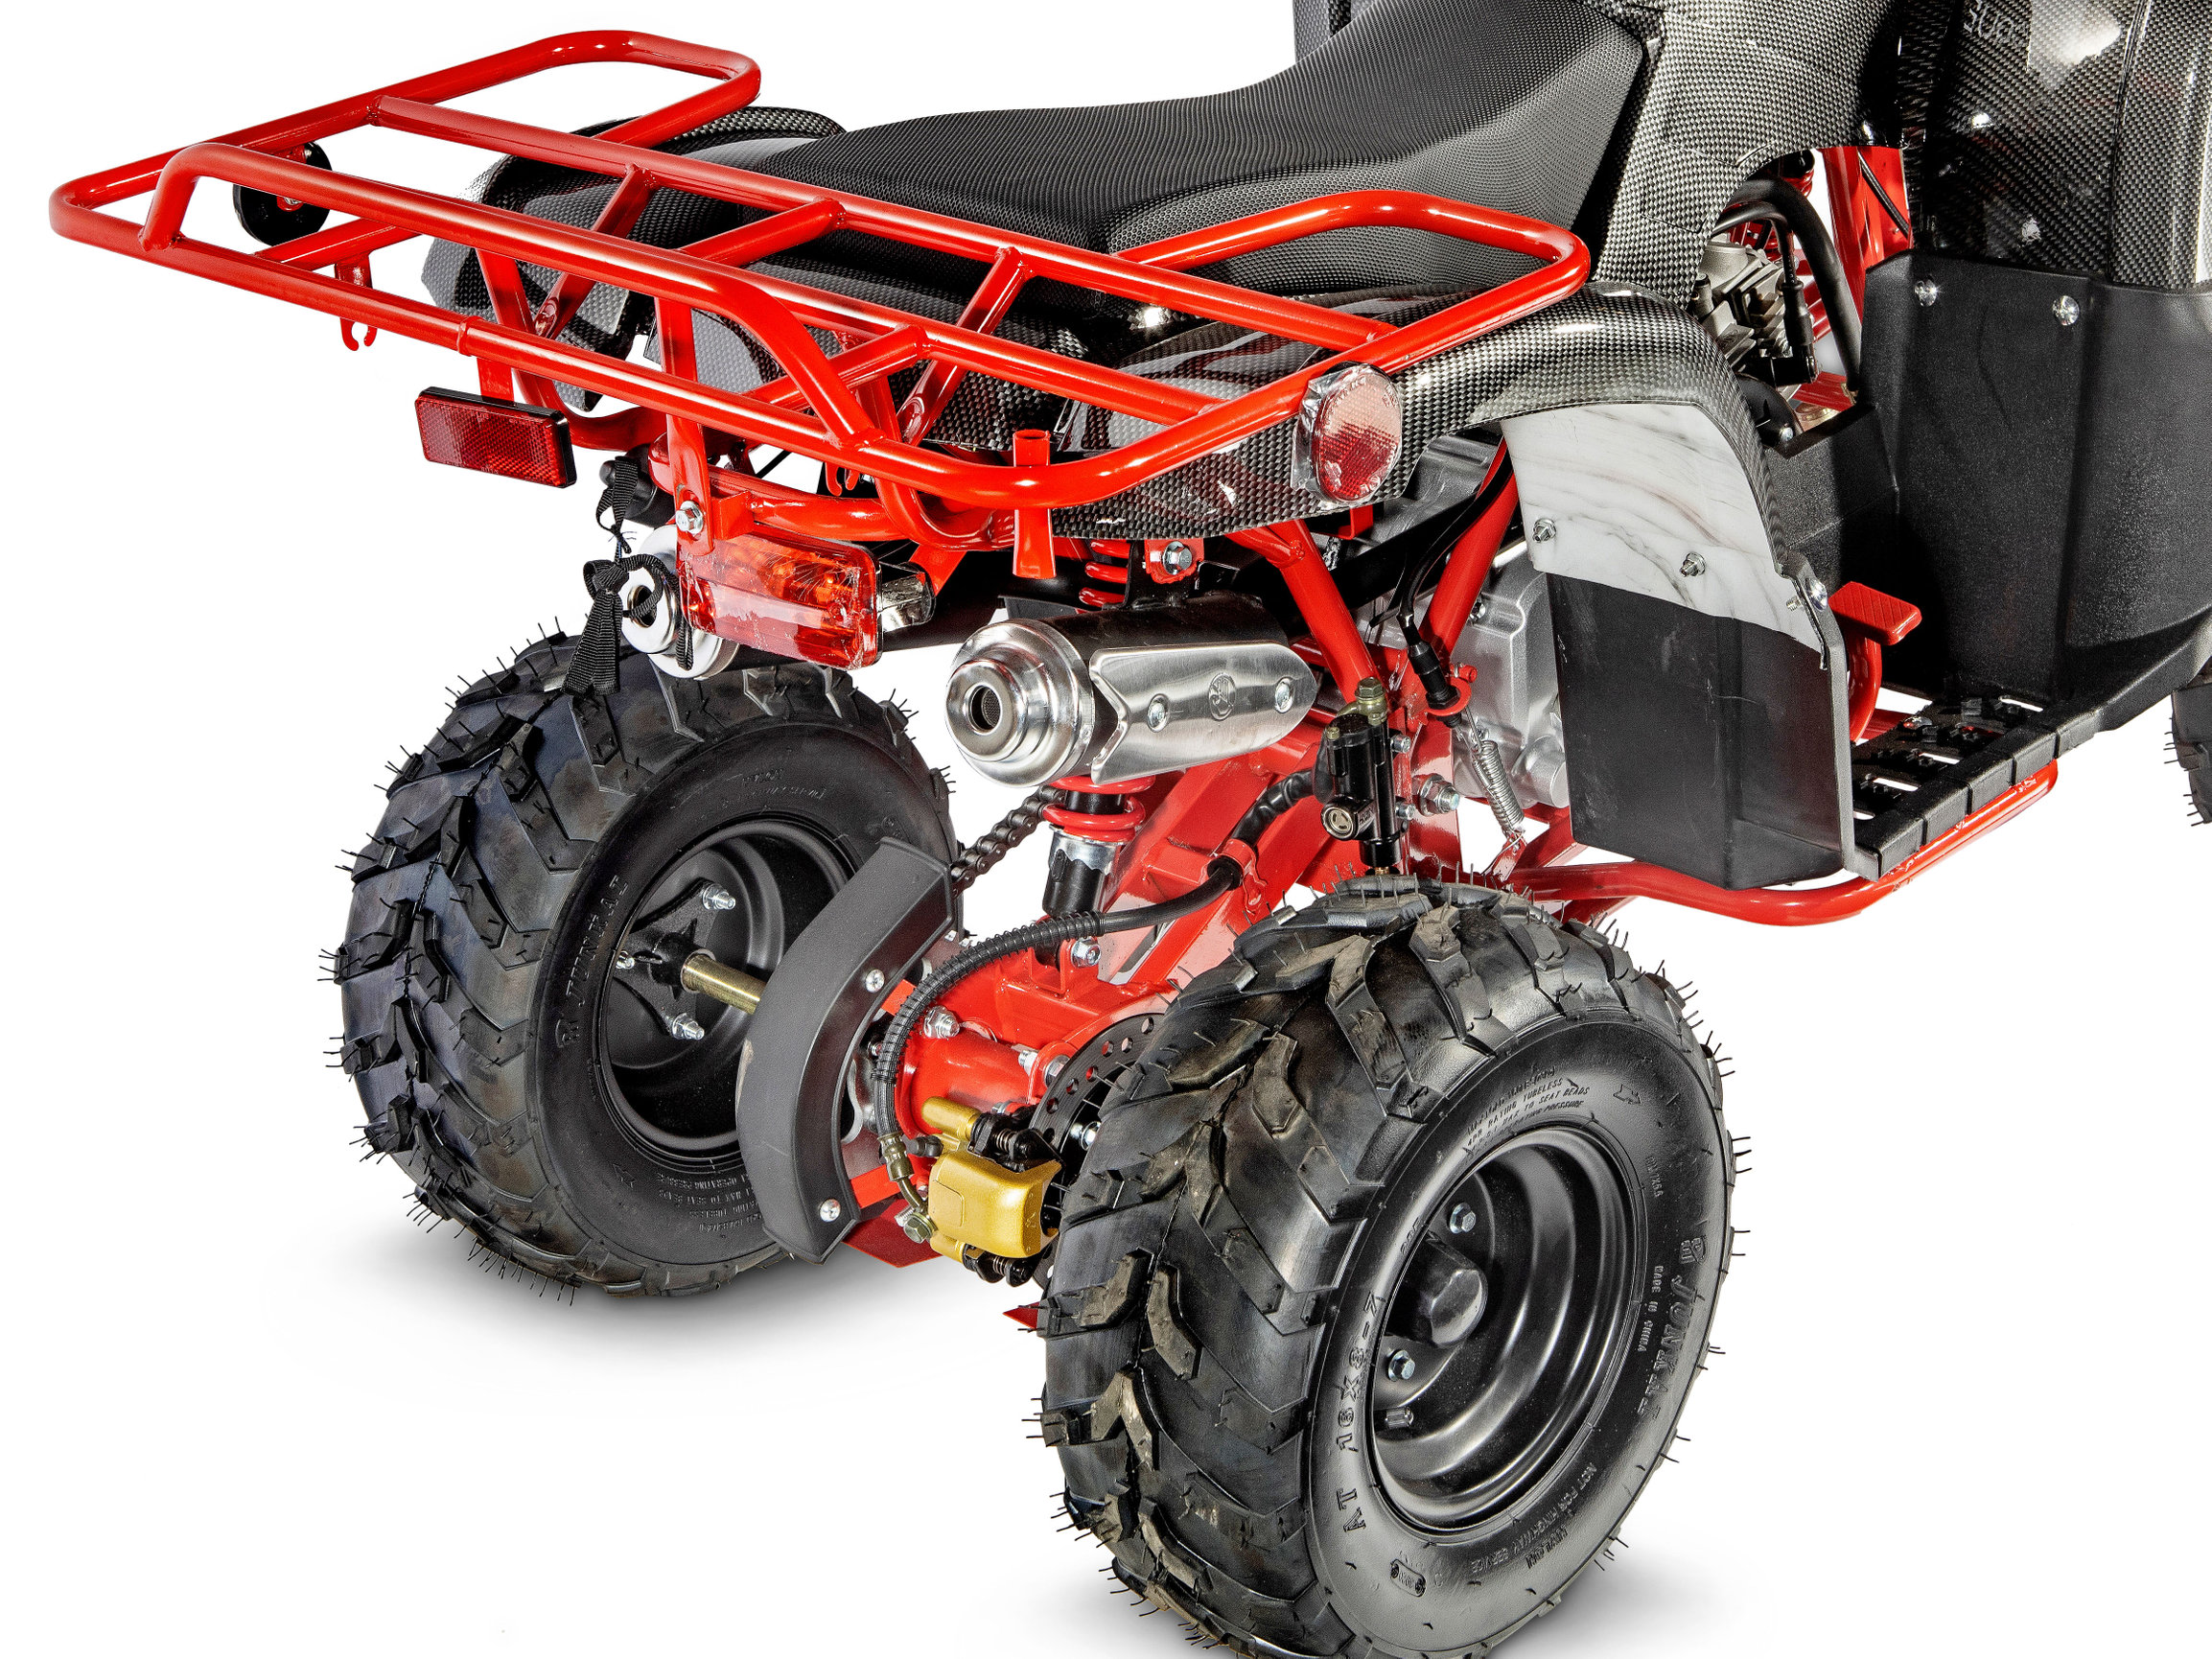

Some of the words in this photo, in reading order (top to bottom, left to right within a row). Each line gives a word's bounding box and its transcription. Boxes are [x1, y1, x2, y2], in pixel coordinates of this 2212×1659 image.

[1523, 1077, 1563, 1103] TUBELESS
[1538, 1091, 1561, 1105] SEAT
[1563, 1086, 1591, 1098] BEADS
[1543, 1100, 1584, 1113] PRESSURE
[1652, 1265, 1664, 1293] MADE
[1647, 1300, 1659, 1313] IN
[1638, 1320, 1653, 1352] CHINA
[1638, 1274, 1697, 1420] JUNKAI
[1576, 1461, 1597, 1490] NOT
[1336, 1487, 1366, 1533] AT
[1557, 1485, 1578, 1512] FOR
[1471, 1547, 1509, 1574] SERVICE
